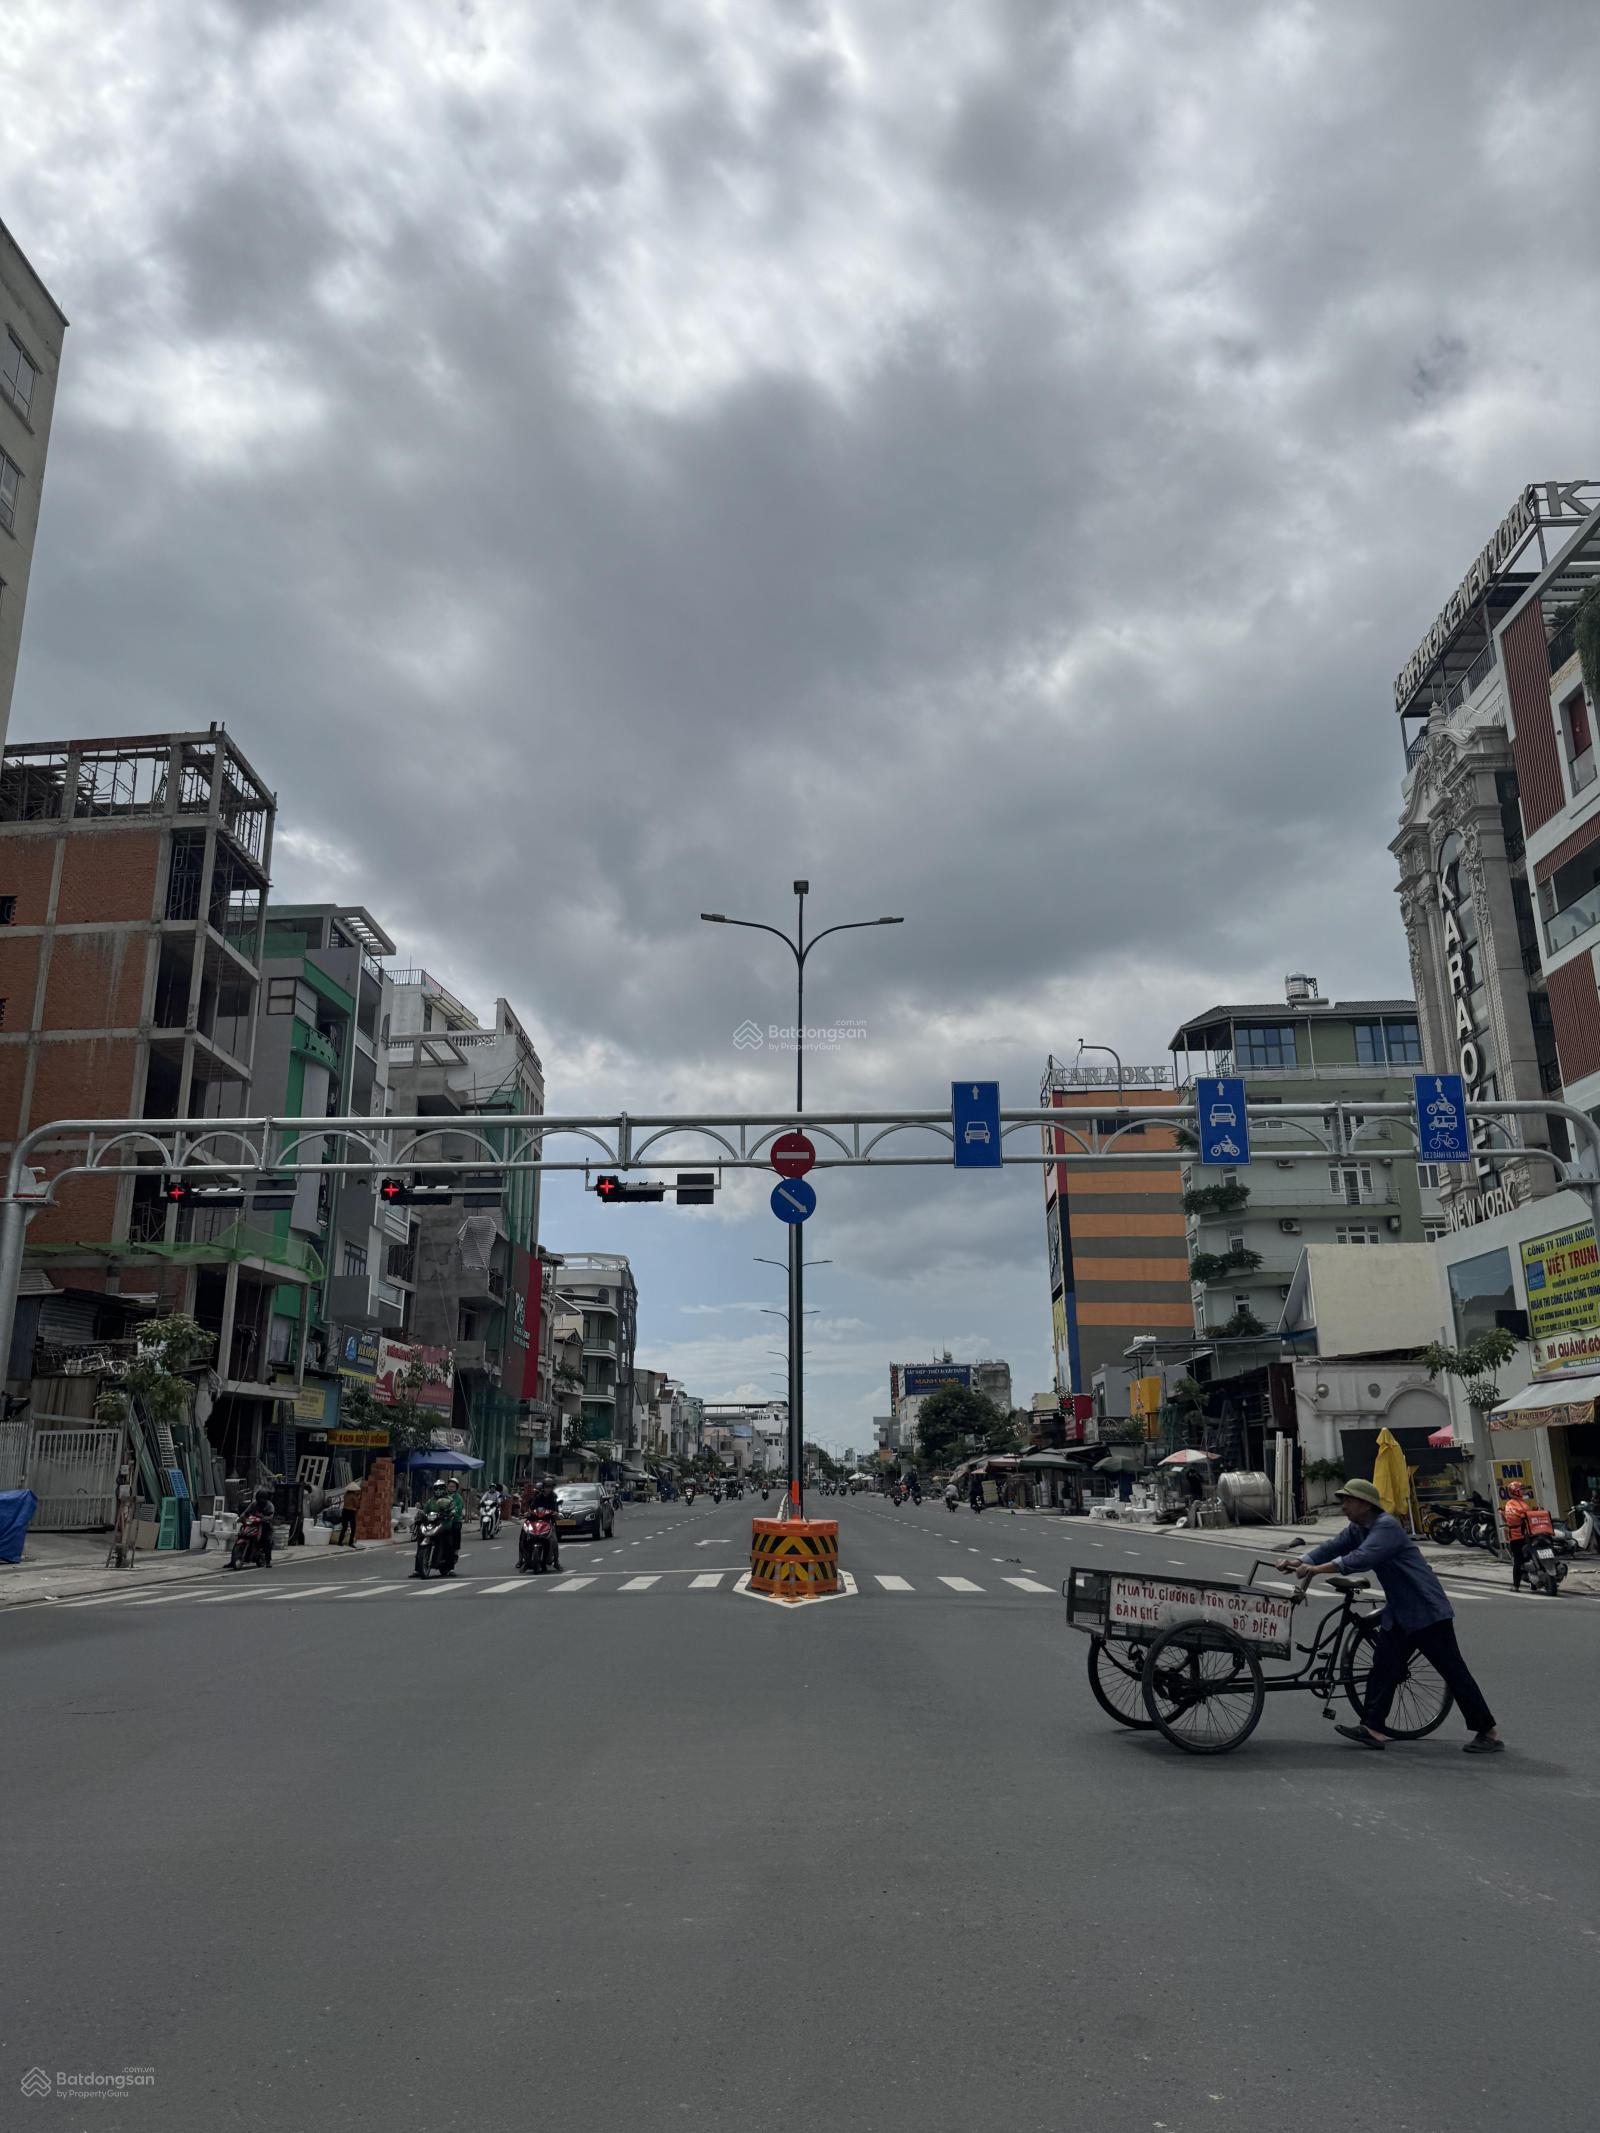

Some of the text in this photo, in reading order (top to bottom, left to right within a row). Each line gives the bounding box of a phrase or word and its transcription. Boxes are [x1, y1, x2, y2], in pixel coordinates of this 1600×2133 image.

[1393, 484, 1535, 712] KARAOKE NEW YORK
[1438, 864, 1491, 1179] KARAOKE
[1050, 1067, 1168, 1085] KARAOKE
[1450, 1183, 1515, 1233] NEW YORK
[1527, 1243, 1545, 1256] CÔNG
[1546, 1240, 1554, 1251] TY
[1546, 1252, 1566, 1277] VIỆT
[1558, 1337, 1587, 1357] QUẢNG
[1117, 1583, 1140, 1597] MUA
[1206, 1592, 1224, 1609] TÔN
[1117, 1600, 1137, 1618] BÀN
[1252, 1617, 1277, 1639] ĐIỆN
